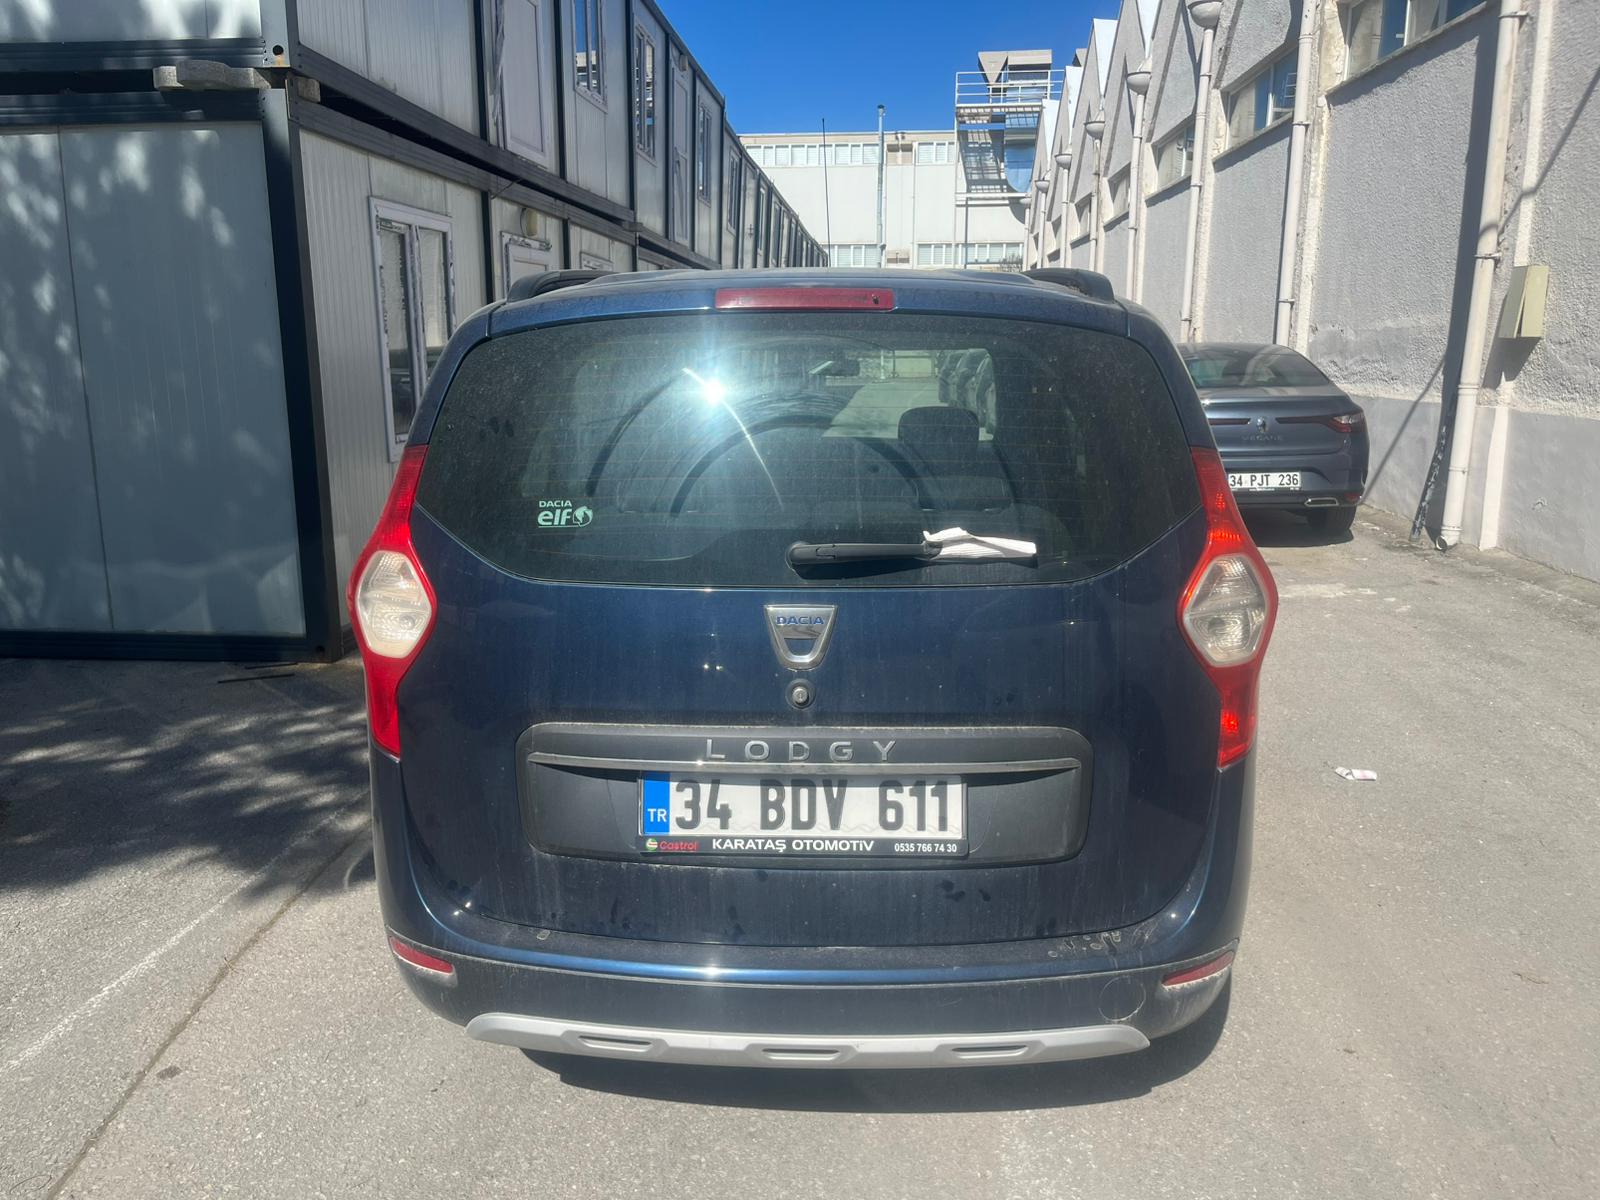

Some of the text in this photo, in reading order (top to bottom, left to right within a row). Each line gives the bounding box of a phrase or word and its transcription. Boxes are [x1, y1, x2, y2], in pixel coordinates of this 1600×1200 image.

[1230, 473, 1299, 487] 34 PJT 236
[539, 500, 573, 508] DACIA
[537, 508, 573, 526] elf
[776, 616, 824, 625] DACIA
[706, 739, 896, 762] LODGY
[675, 779, 949, 832] 34 BDV 611
[647, 808, 667, 823] TR
[659, 840, 698, 851] Castrol
[712, 838, 787, 853] KARATAŞ
[894, 842, 958, 853] 0535 766 74 30
